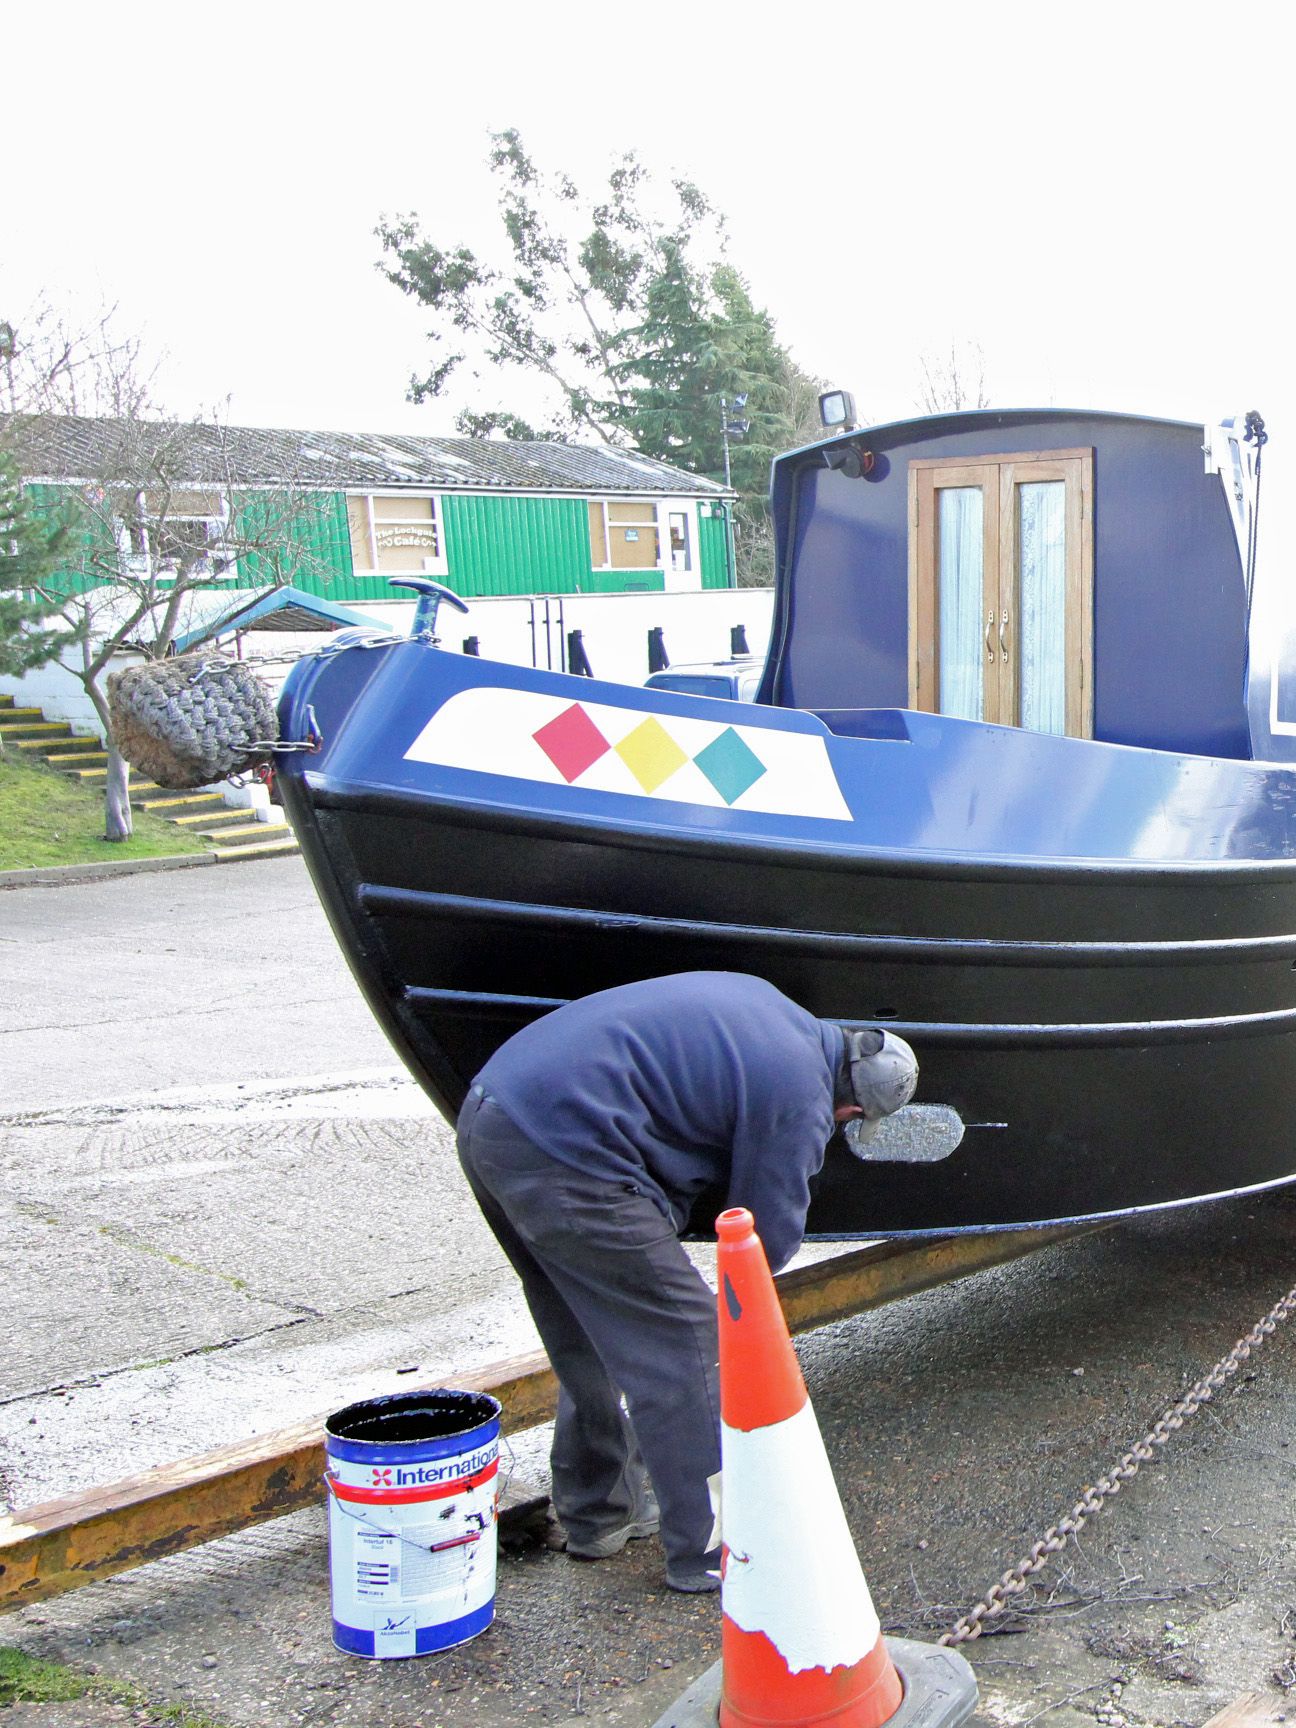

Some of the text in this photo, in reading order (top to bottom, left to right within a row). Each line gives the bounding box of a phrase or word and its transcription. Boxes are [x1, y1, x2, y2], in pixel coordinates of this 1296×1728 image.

[375, 526, 437, 540] The Lockgate
[393, 535, 420, 546] Café
[396, 1443, 498, 1486] Internationa
